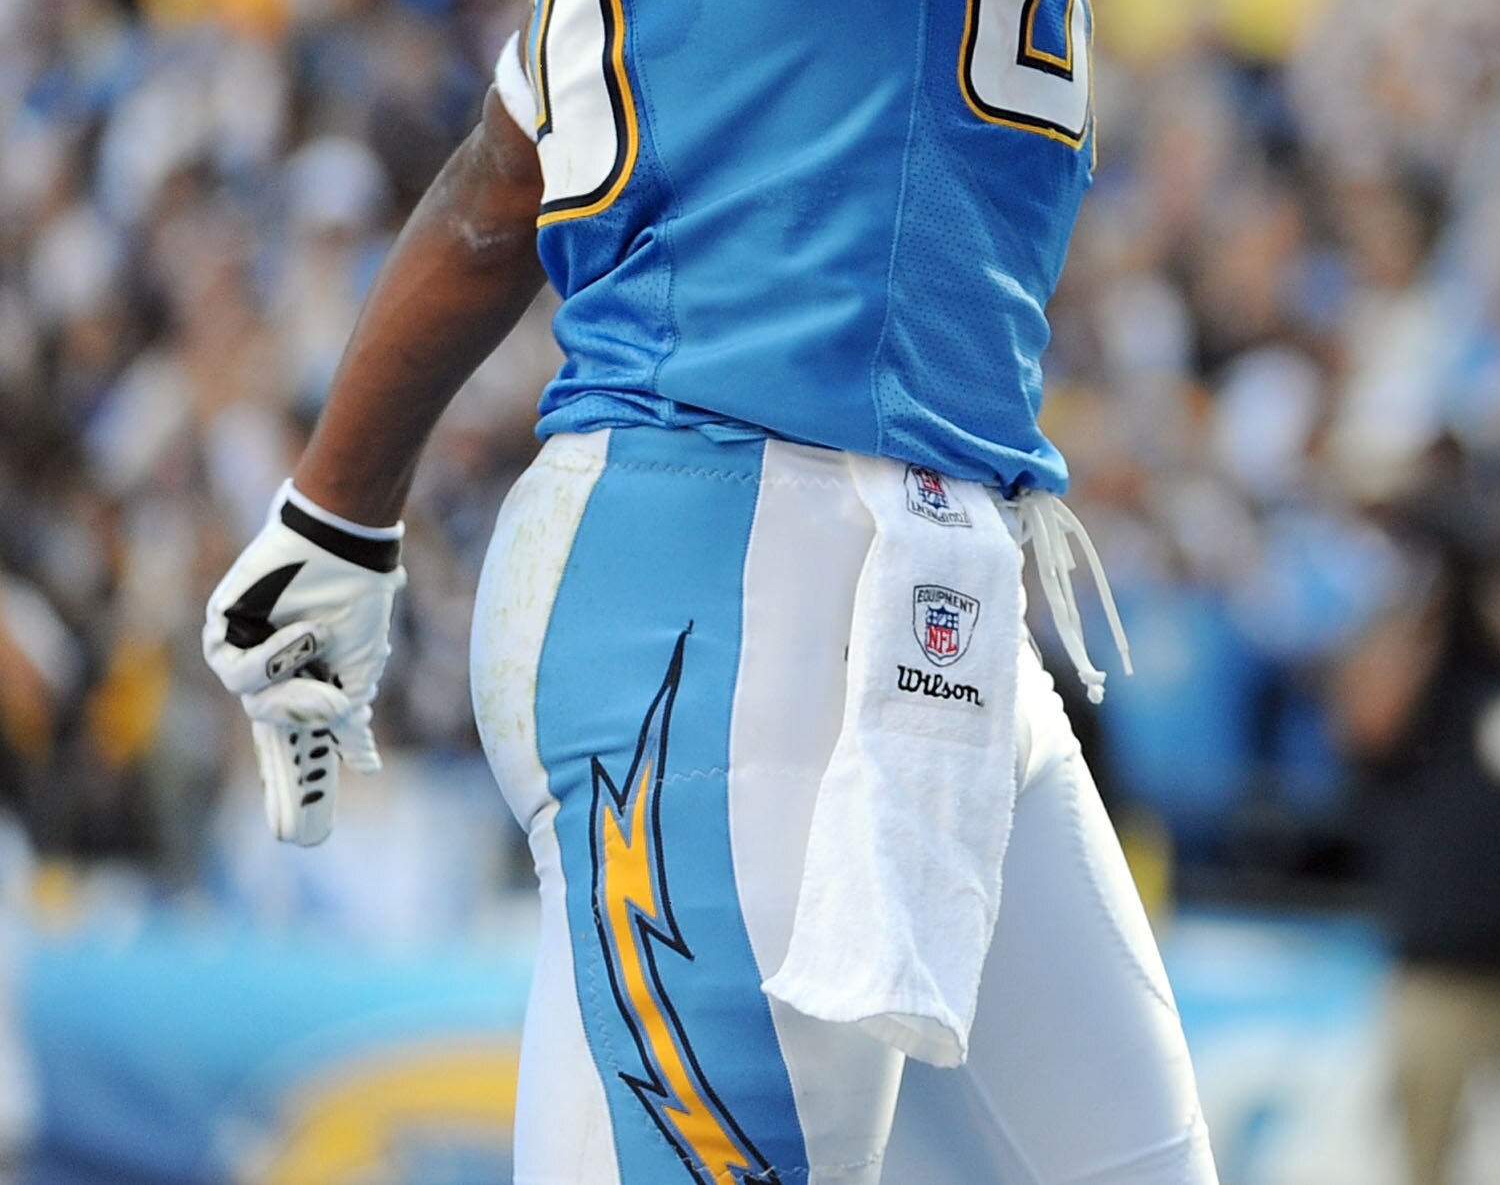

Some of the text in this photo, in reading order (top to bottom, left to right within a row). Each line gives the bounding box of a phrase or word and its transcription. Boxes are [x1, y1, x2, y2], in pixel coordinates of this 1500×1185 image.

[916, 588, 975, 615] EQUIPMENT
[926, 624, 958, 654] NFL
[896, 664, 984, 707] Wilson
